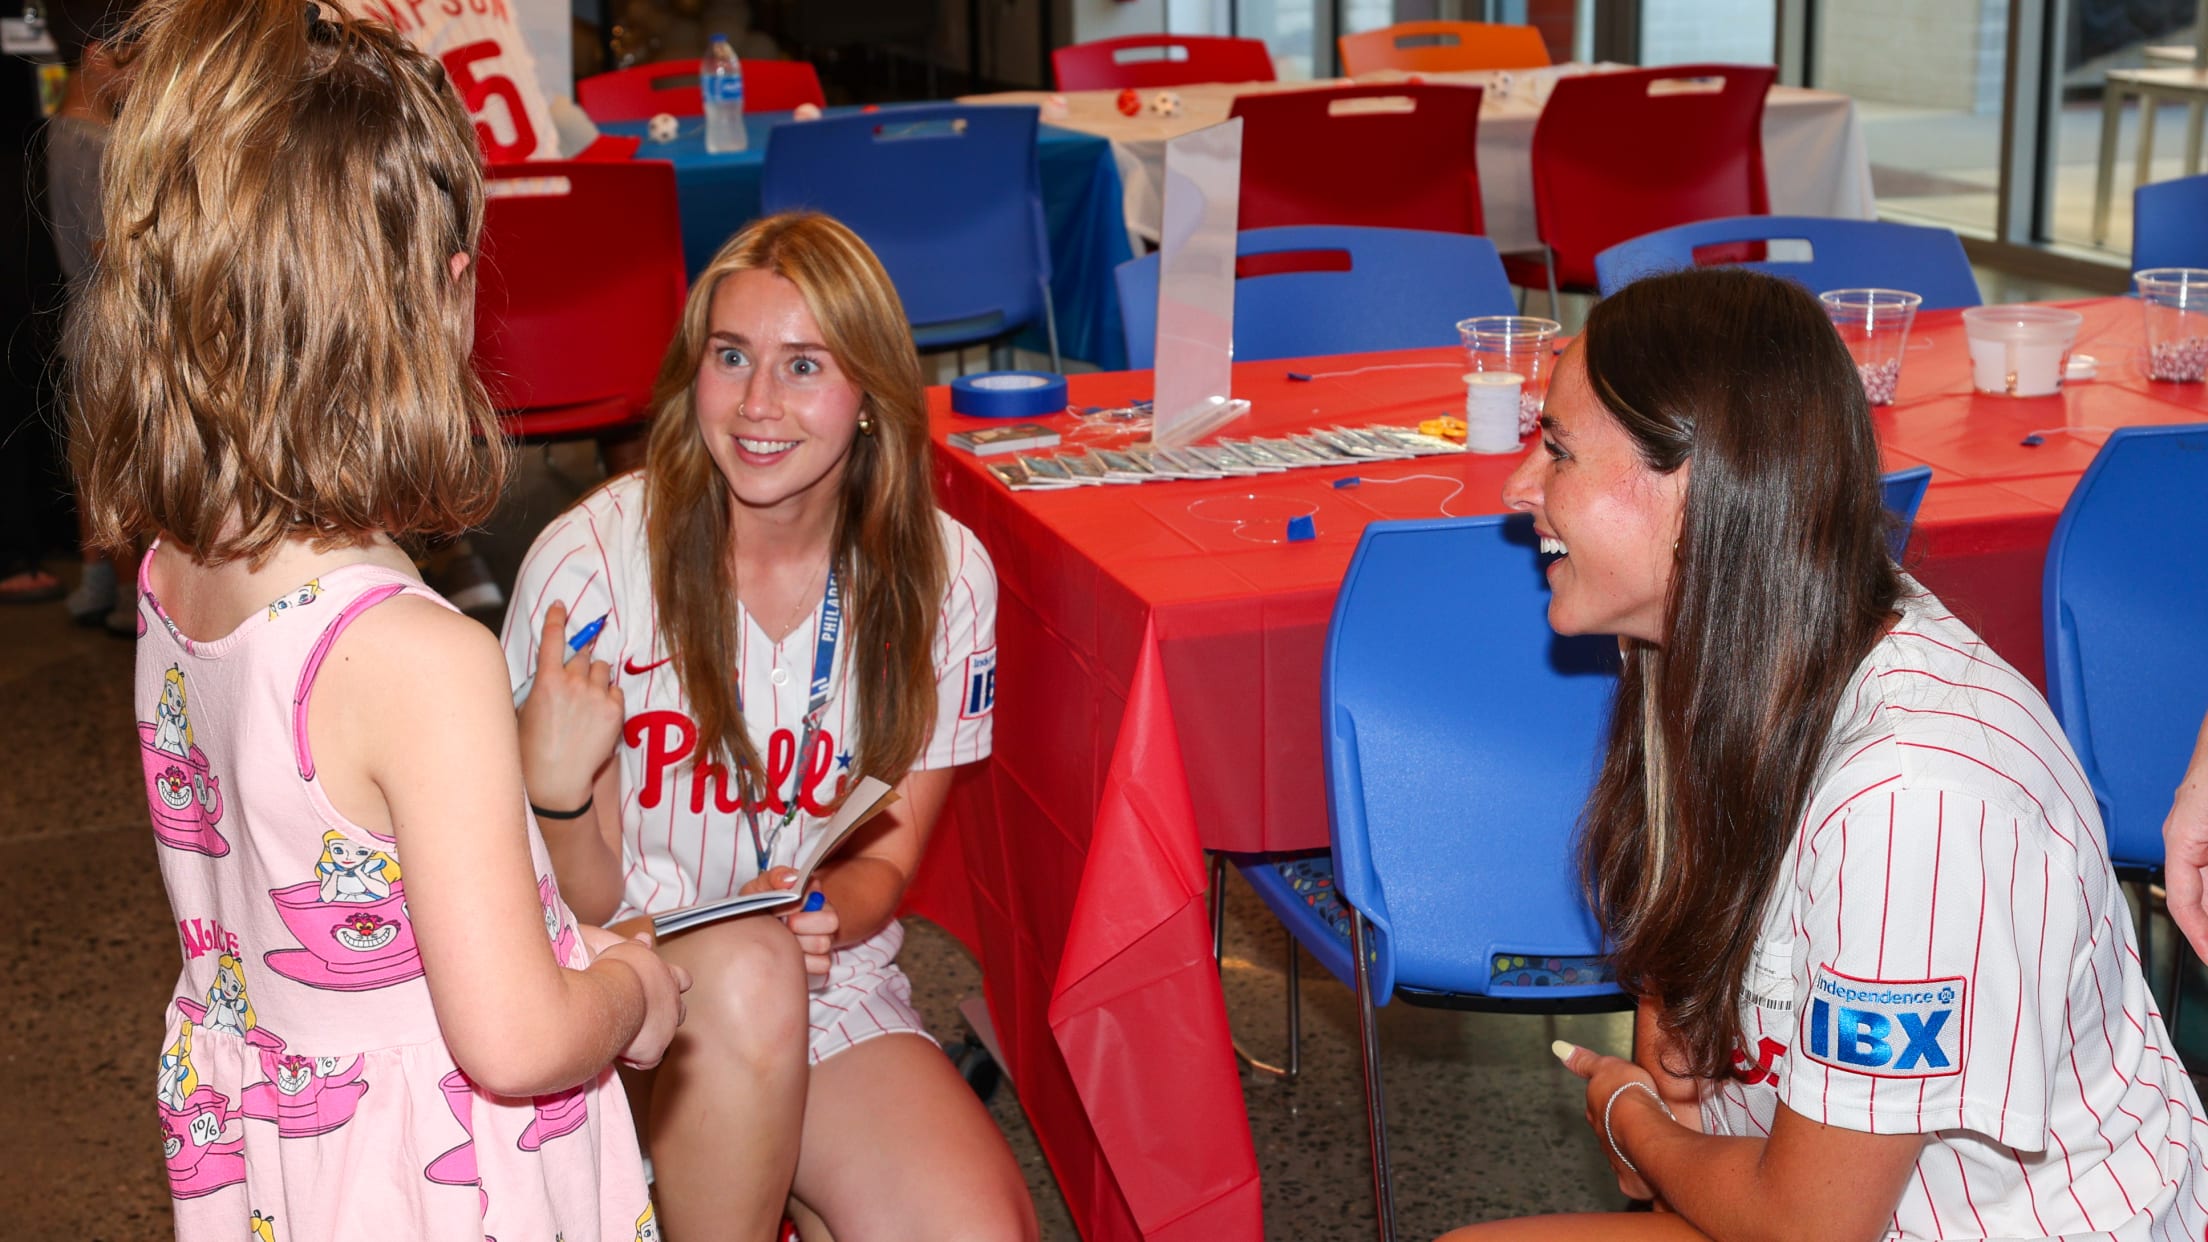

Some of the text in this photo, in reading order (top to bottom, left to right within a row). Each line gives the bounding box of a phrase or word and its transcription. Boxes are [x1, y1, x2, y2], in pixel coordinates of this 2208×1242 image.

[179, 917, 240, 960] ALICE
[1816, 973, 1933, 1005] Independence
[1810, 996, 1953, 1070] IBX
[192, 1117, 217, 1139] 10/6
